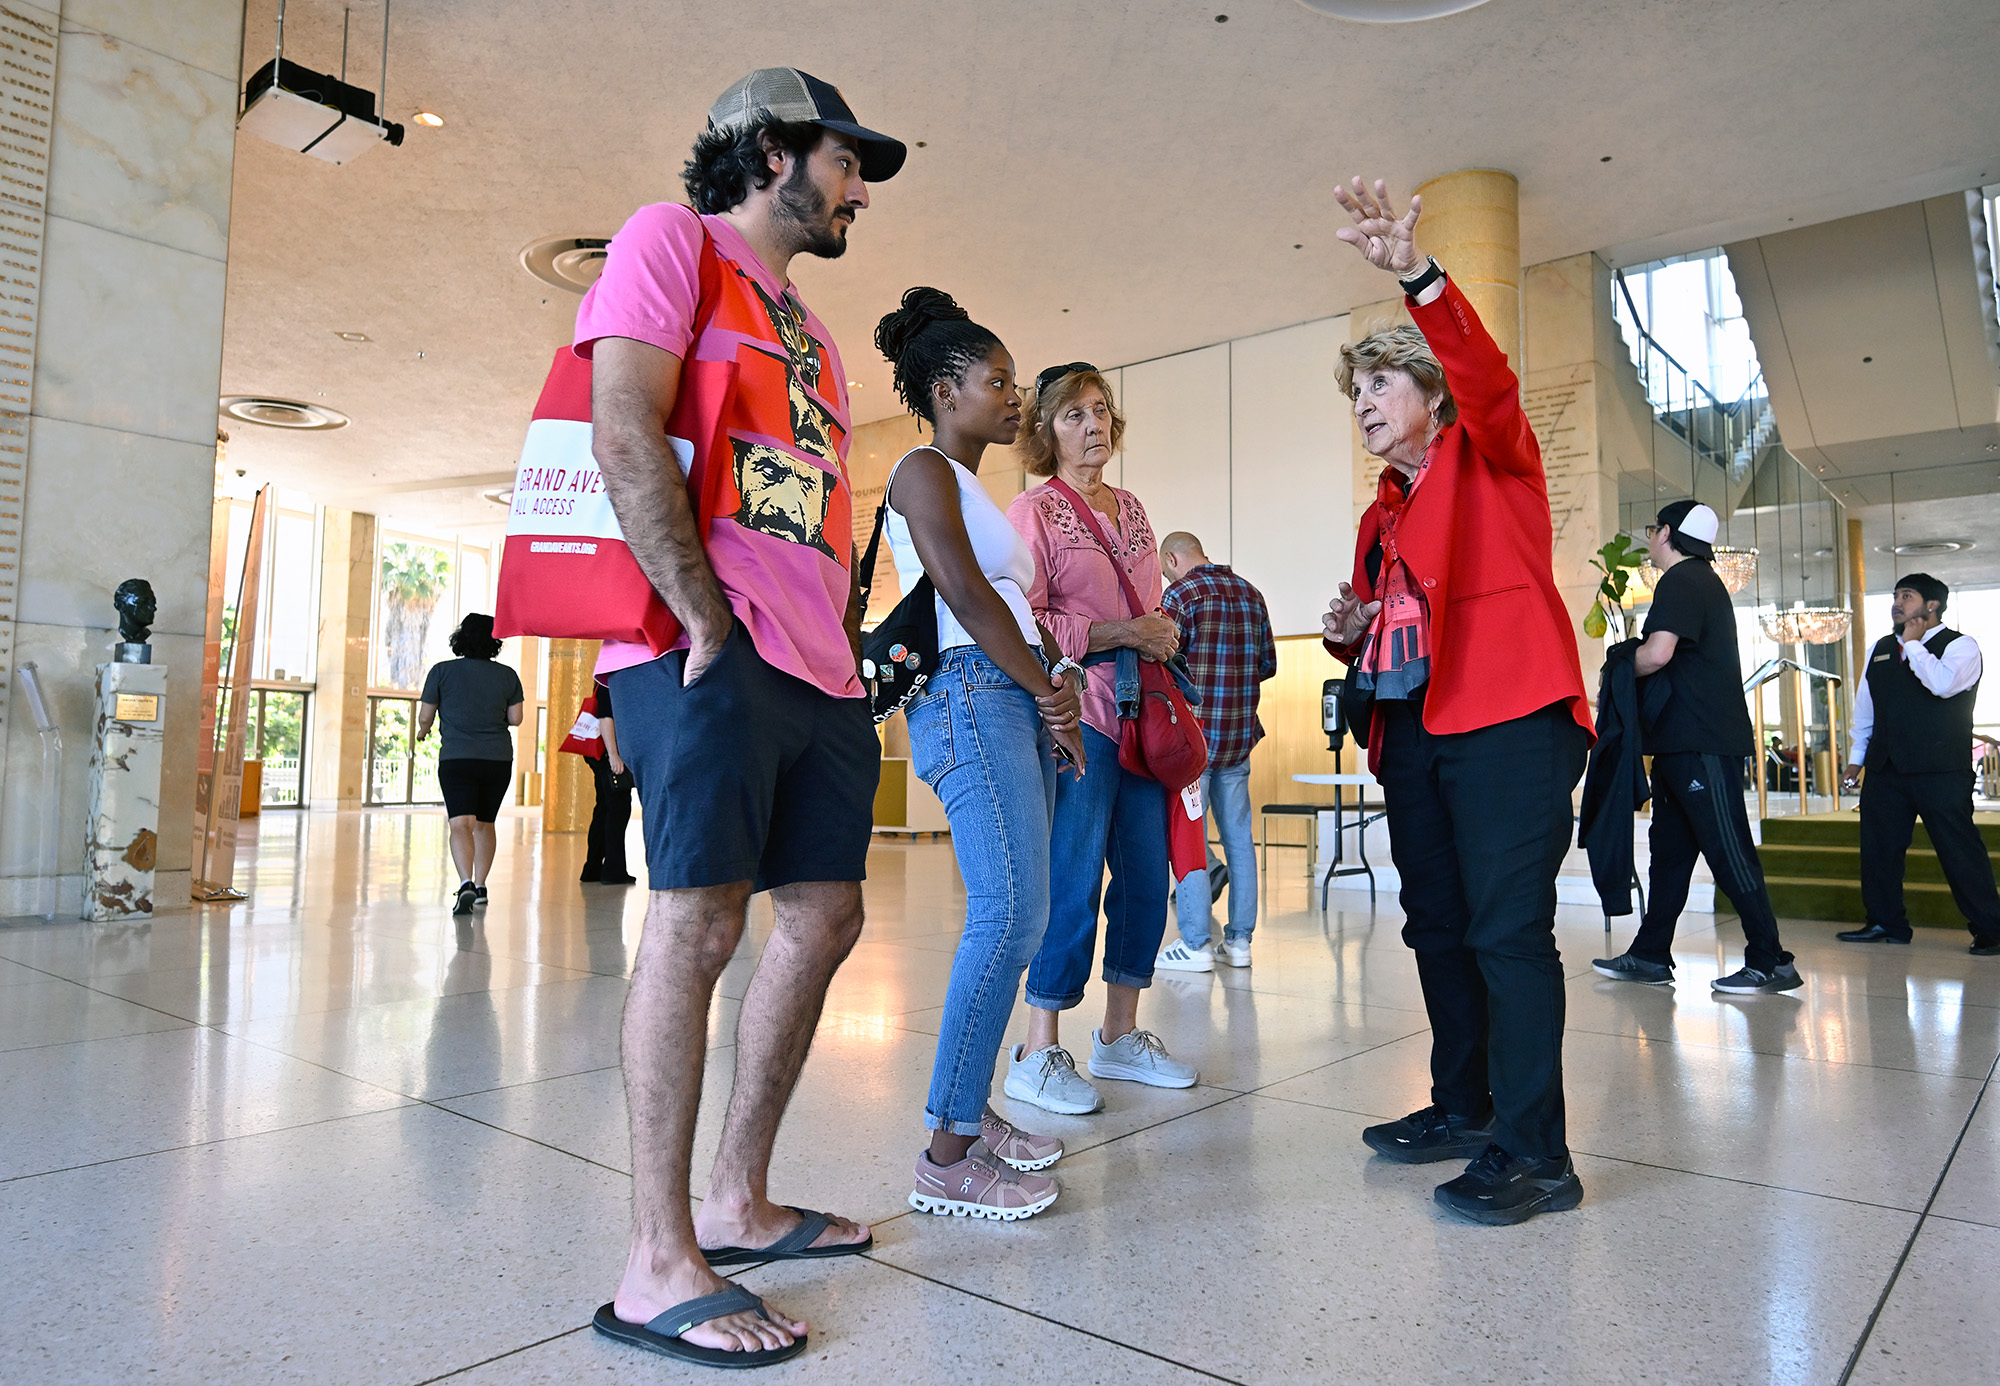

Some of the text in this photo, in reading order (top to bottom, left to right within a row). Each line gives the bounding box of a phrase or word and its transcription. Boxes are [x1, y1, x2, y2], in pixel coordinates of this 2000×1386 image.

[4, 60, 50, 79] PAULEY
[10, 111, 48, 128] MUDD
[519, 467, 601, 494] GRAND AVE
[531, 497, 576, 516] ACCESS
[873, 673, 929, 723] adidas
